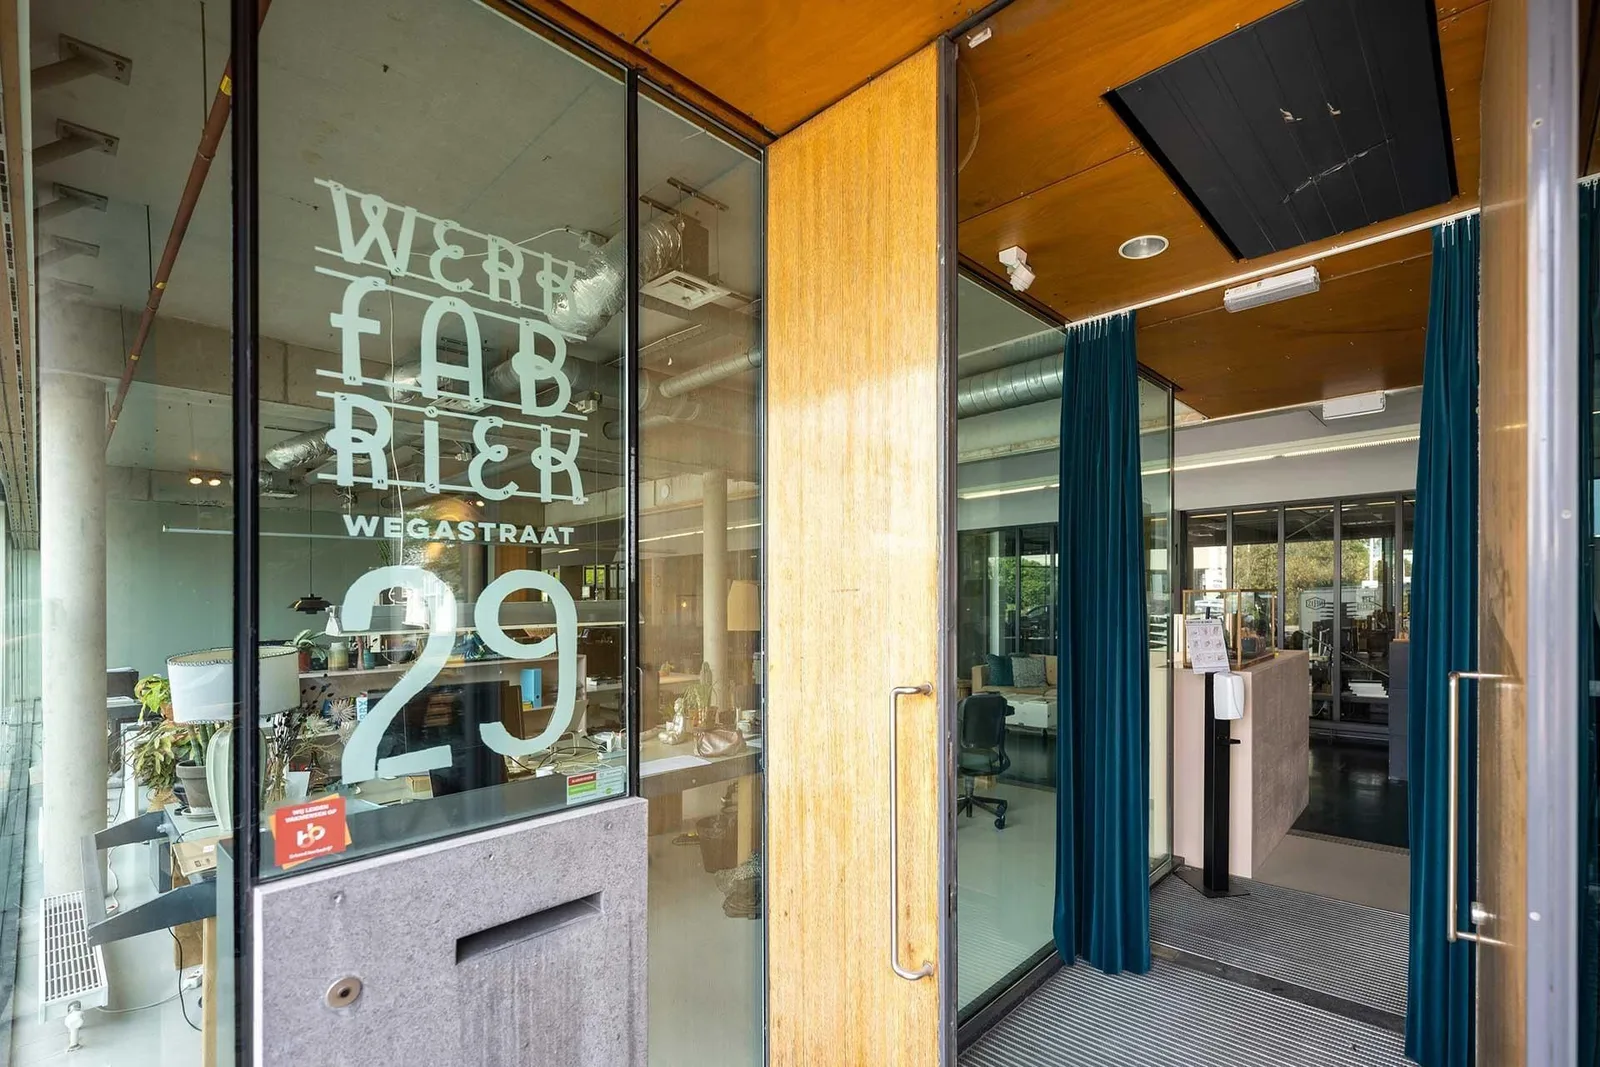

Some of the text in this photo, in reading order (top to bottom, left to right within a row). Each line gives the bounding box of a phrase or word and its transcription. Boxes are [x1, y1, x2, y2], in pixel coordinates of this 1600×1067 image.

[328, 180, 579, 322] WERK
[342, 514, 575, 545] WEGASTRAAT
[341, 565, 578, 784] 29
